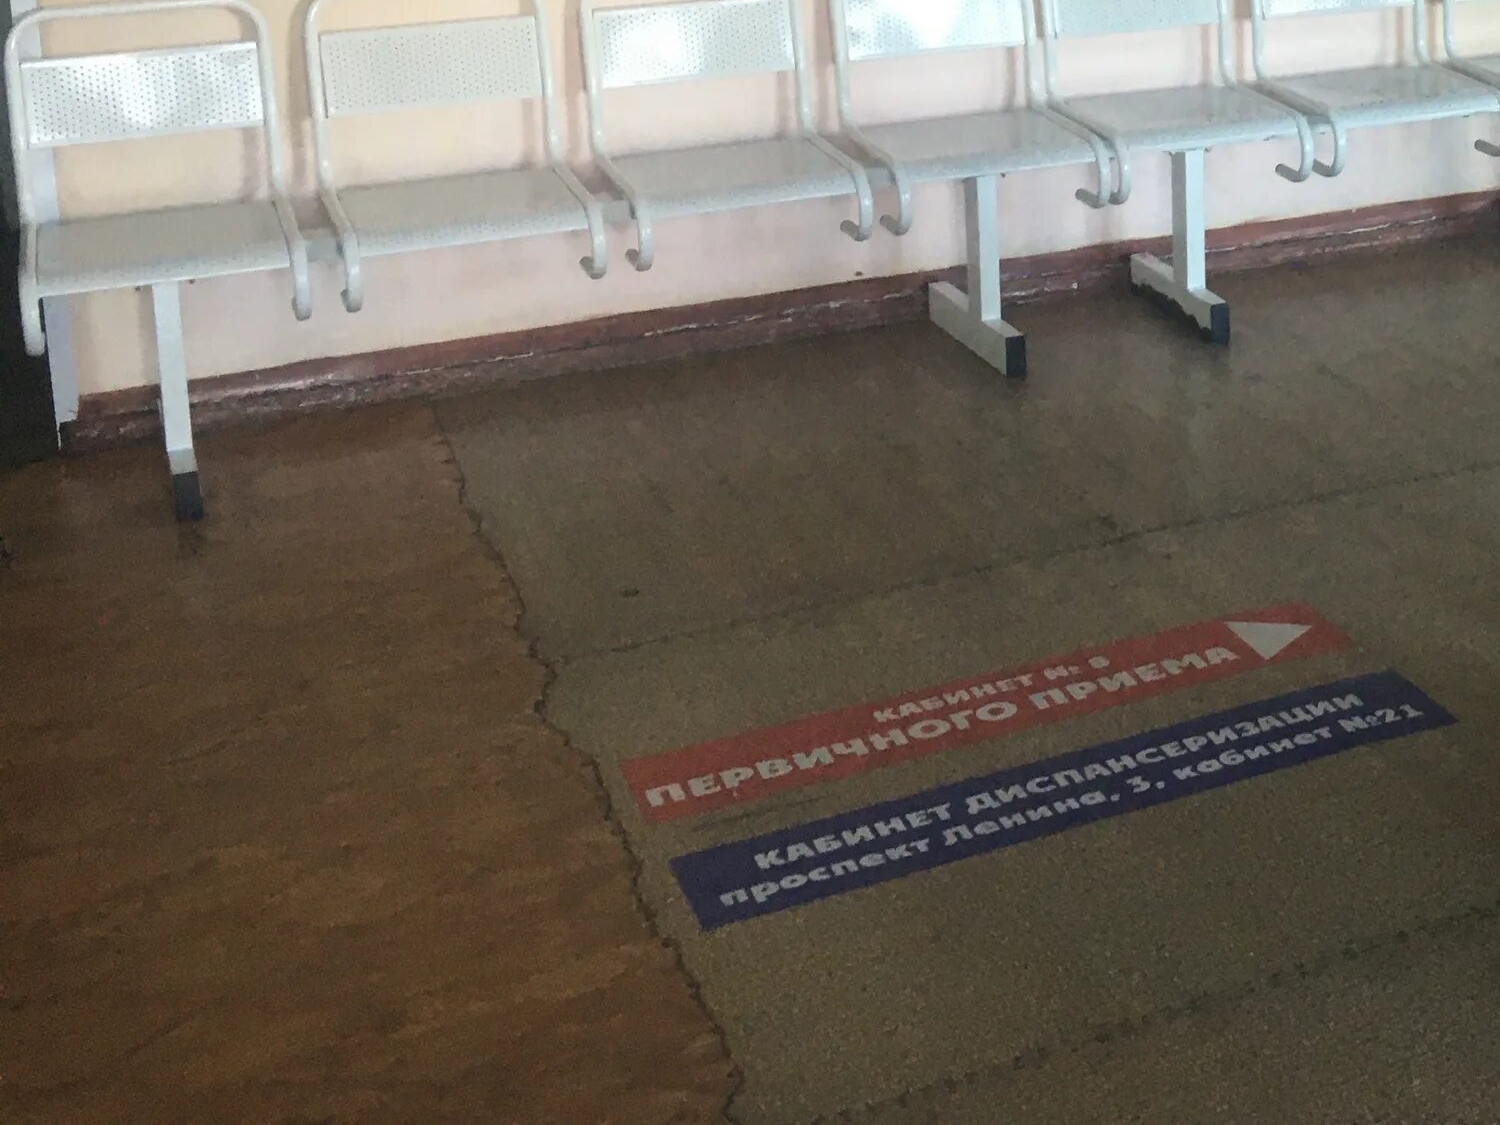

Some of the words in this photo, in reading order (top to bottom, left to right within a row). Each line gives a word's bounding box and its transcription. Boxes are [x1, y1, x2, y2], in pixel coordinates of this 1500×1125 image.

[644, 701, 1018, 809] ПЕРВИЧНОГО
[1029, 645, 1241, 712] ПРИЕМА
[753, 802, 953, 870] КАБИНЕТ
[963, 691, 1364, 817] ДИСПАНСЕРИЗАЦИИ
[872, 673, 1033, 724] КАБИНЕТ
[718, 837, 931, 907] проспект
[941, 786, 1120, 848] Ленина,
[1126, 774, 1167, 795] 3,
[1171, 724, 1333, 782] кабинет
[1339, 703, 1425, 735] №21
